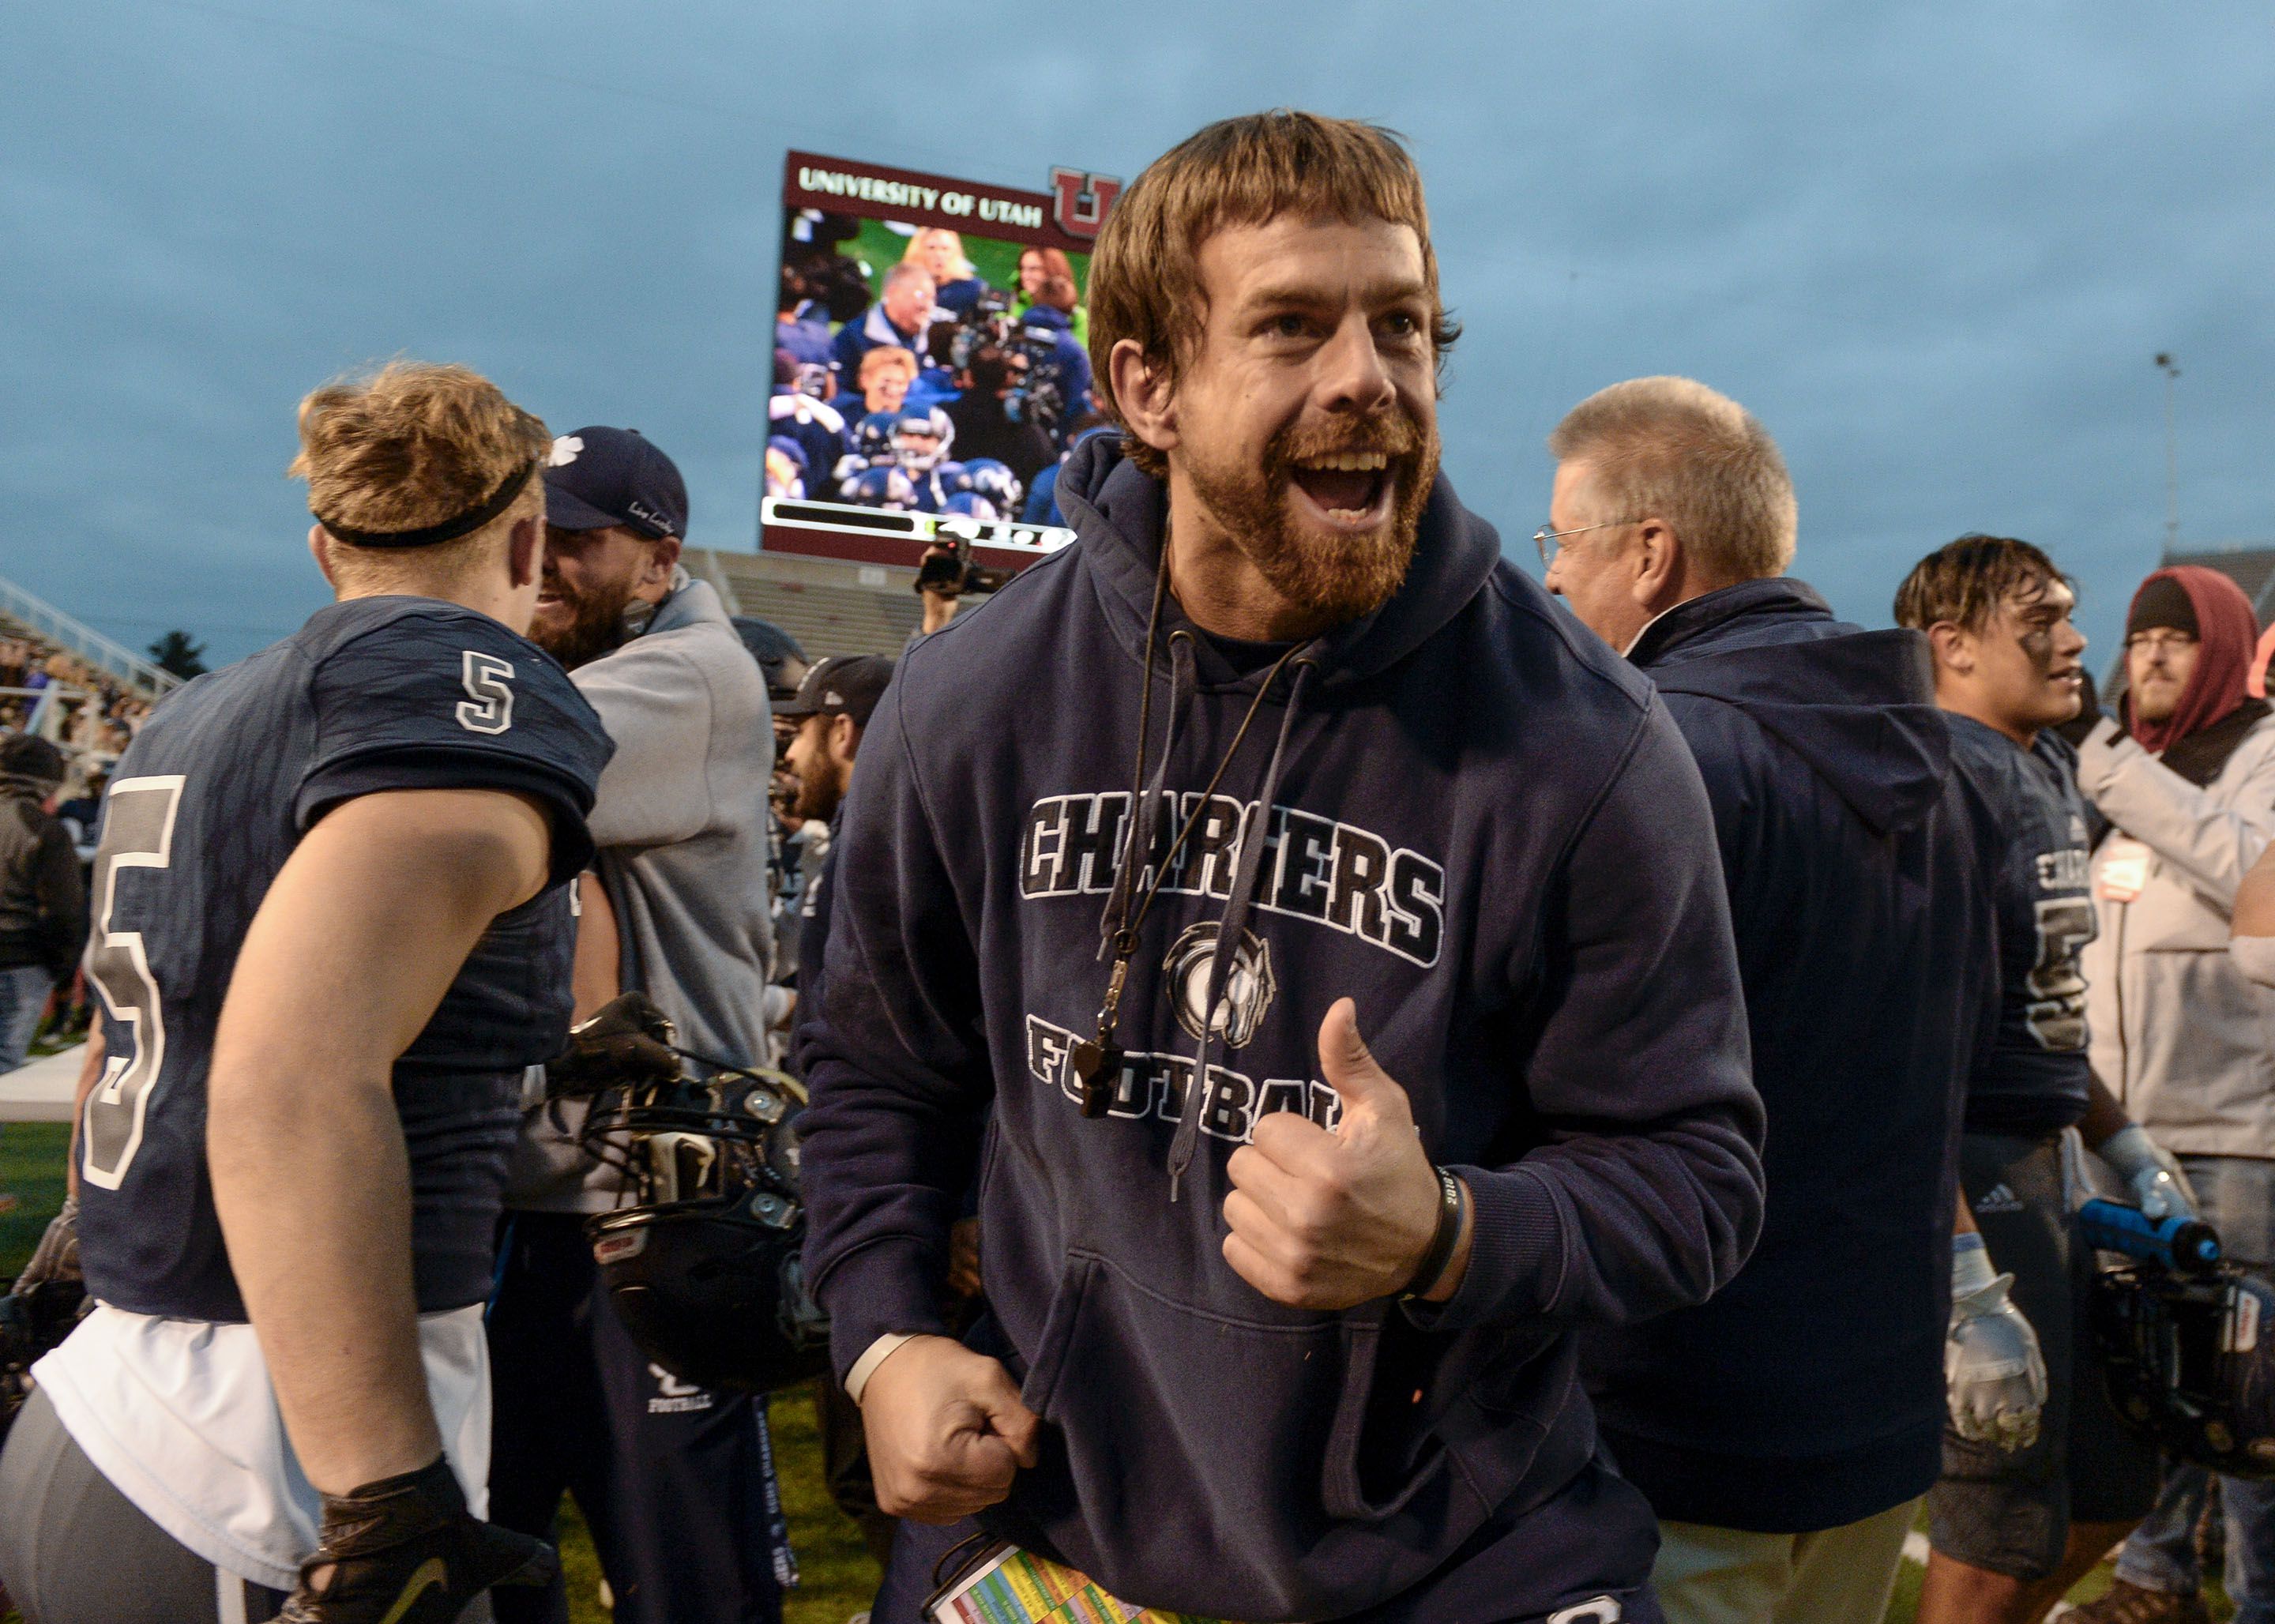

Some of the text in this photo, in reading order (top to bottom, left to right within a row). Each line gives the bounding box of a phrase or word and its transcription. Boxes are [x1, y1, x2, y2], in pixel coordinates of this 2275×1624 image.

[799, 167, 1043, 228] UNIVERSITY OF UTAH
[1051, 166, 1122, 238] U
[455, 650, 515, 735] 5
[82, 775, 187, 1191] 5
